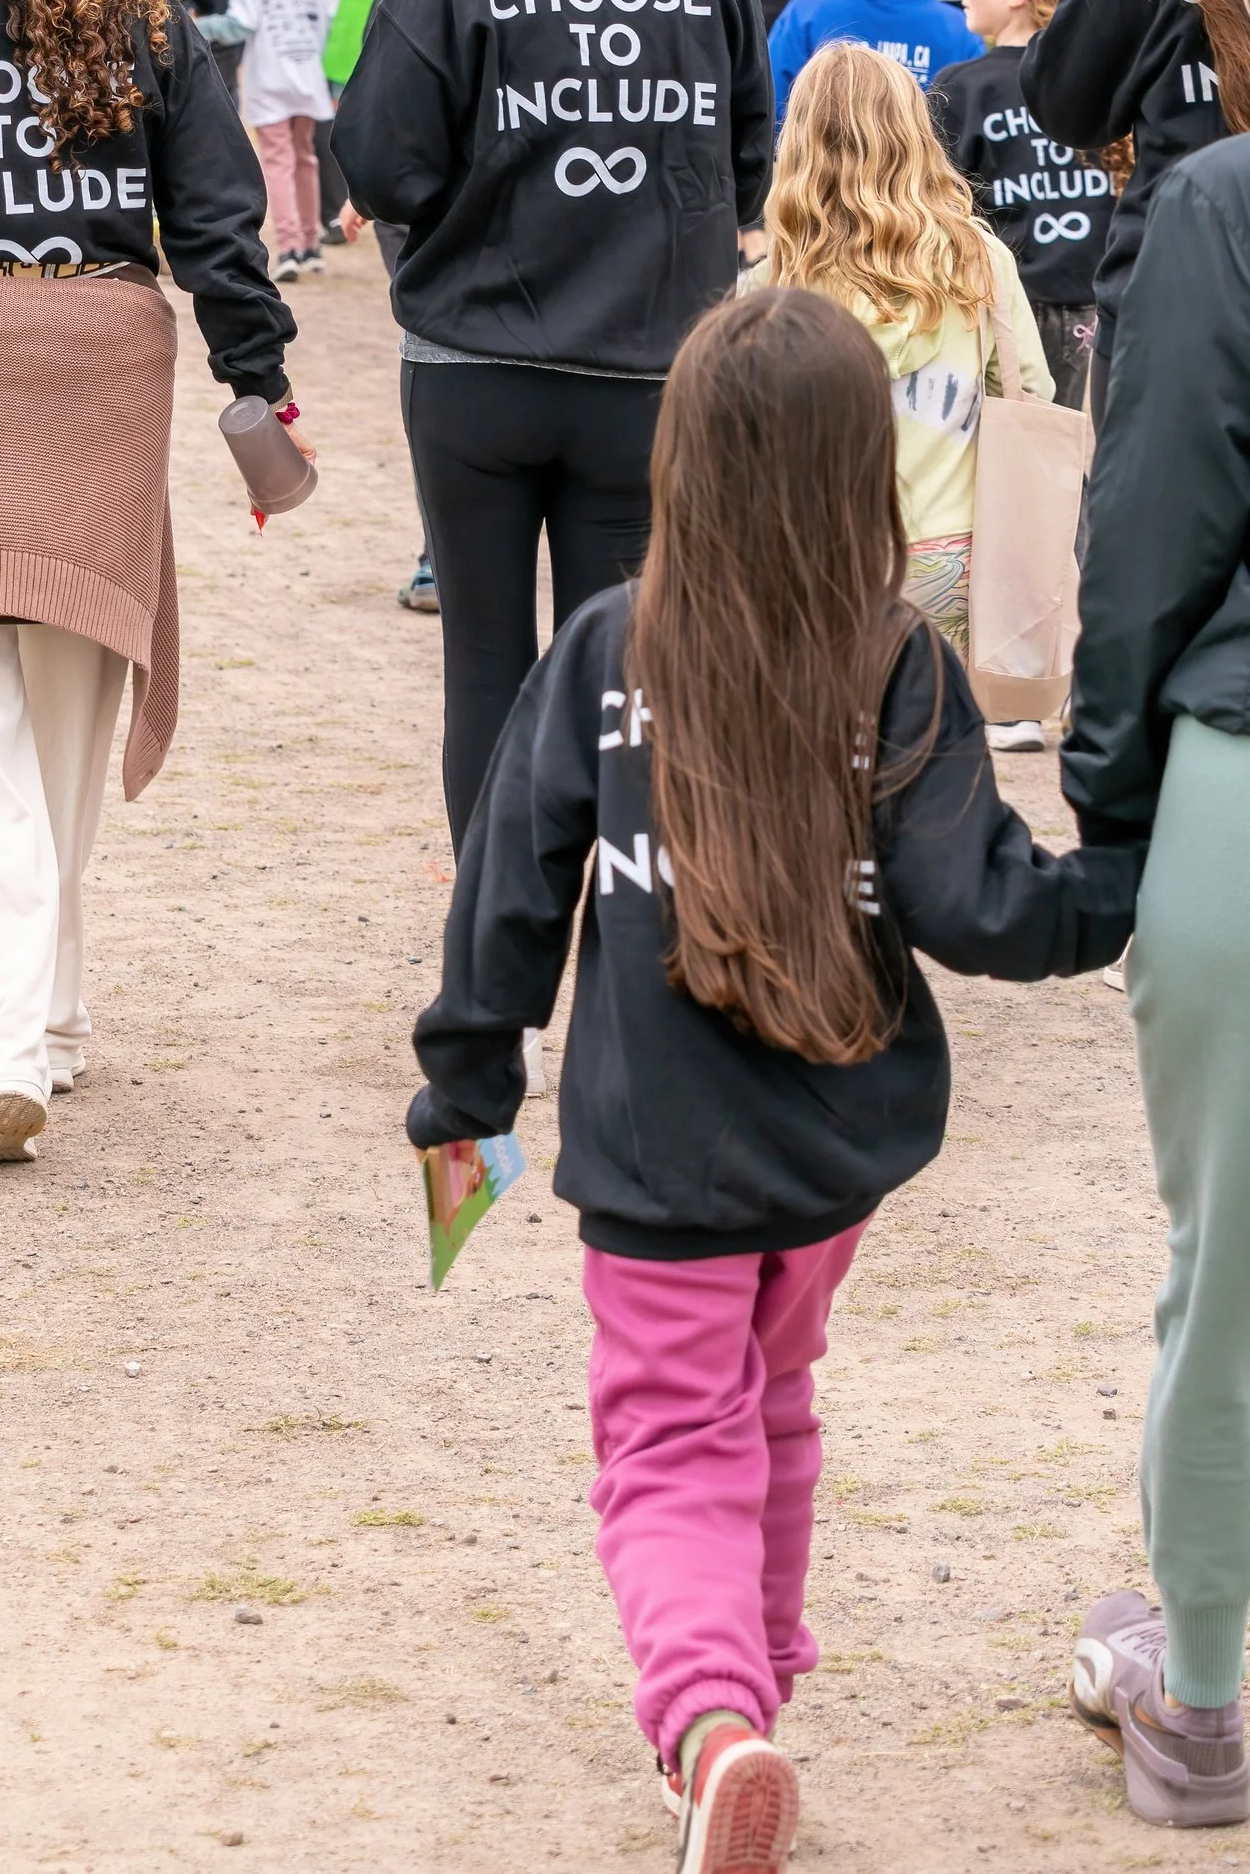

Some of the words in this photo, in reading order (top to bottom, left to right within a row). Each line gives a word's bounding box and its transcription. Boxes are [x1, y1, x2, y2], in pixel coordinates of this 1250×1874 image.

[569, 23, 641, 67] TO
[496, 78, 717, 132] INCLUDE
[1030, 138, 1074, 167] TO
